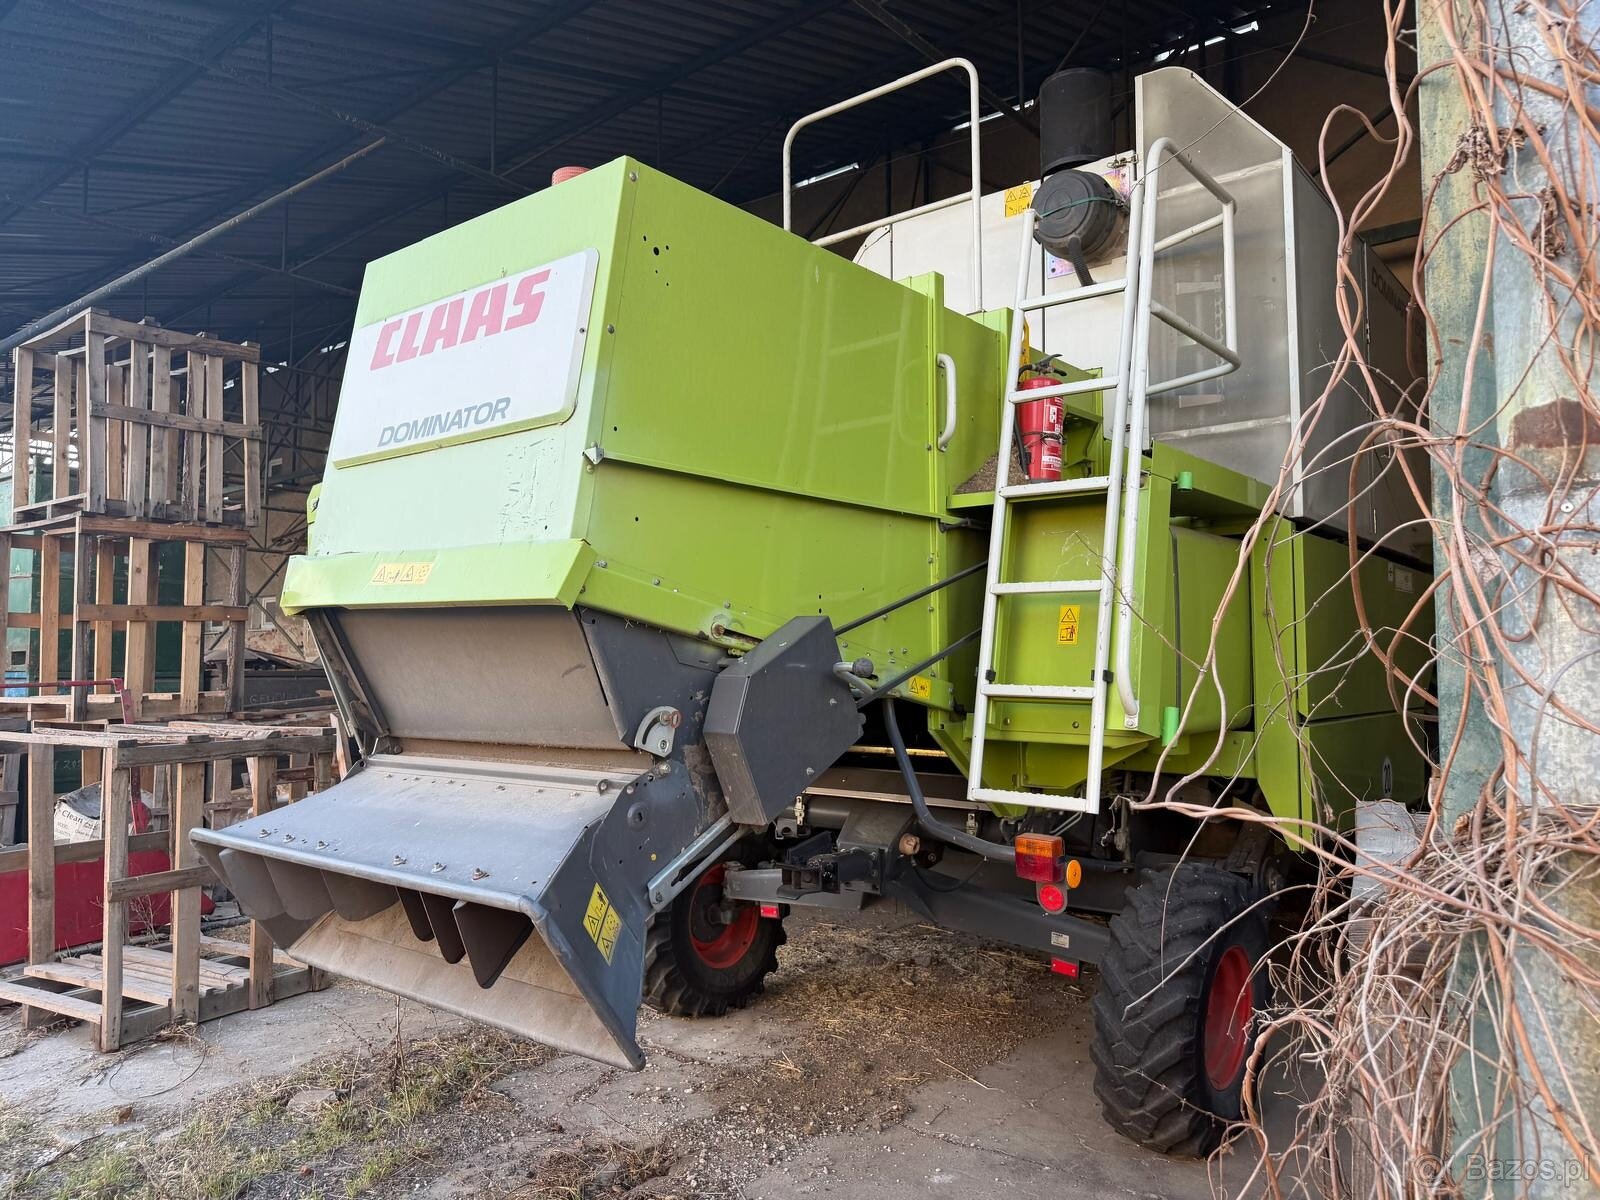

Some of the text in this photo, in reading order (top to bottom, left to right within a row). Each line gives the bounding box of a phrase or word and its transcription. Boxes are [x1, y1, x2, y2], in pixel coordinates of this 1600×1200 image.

[370, 268, 551, 372] CLAAS
[377, 396, 511, 449] DOMINATOR
[61, 809, 84, 824] Clean
